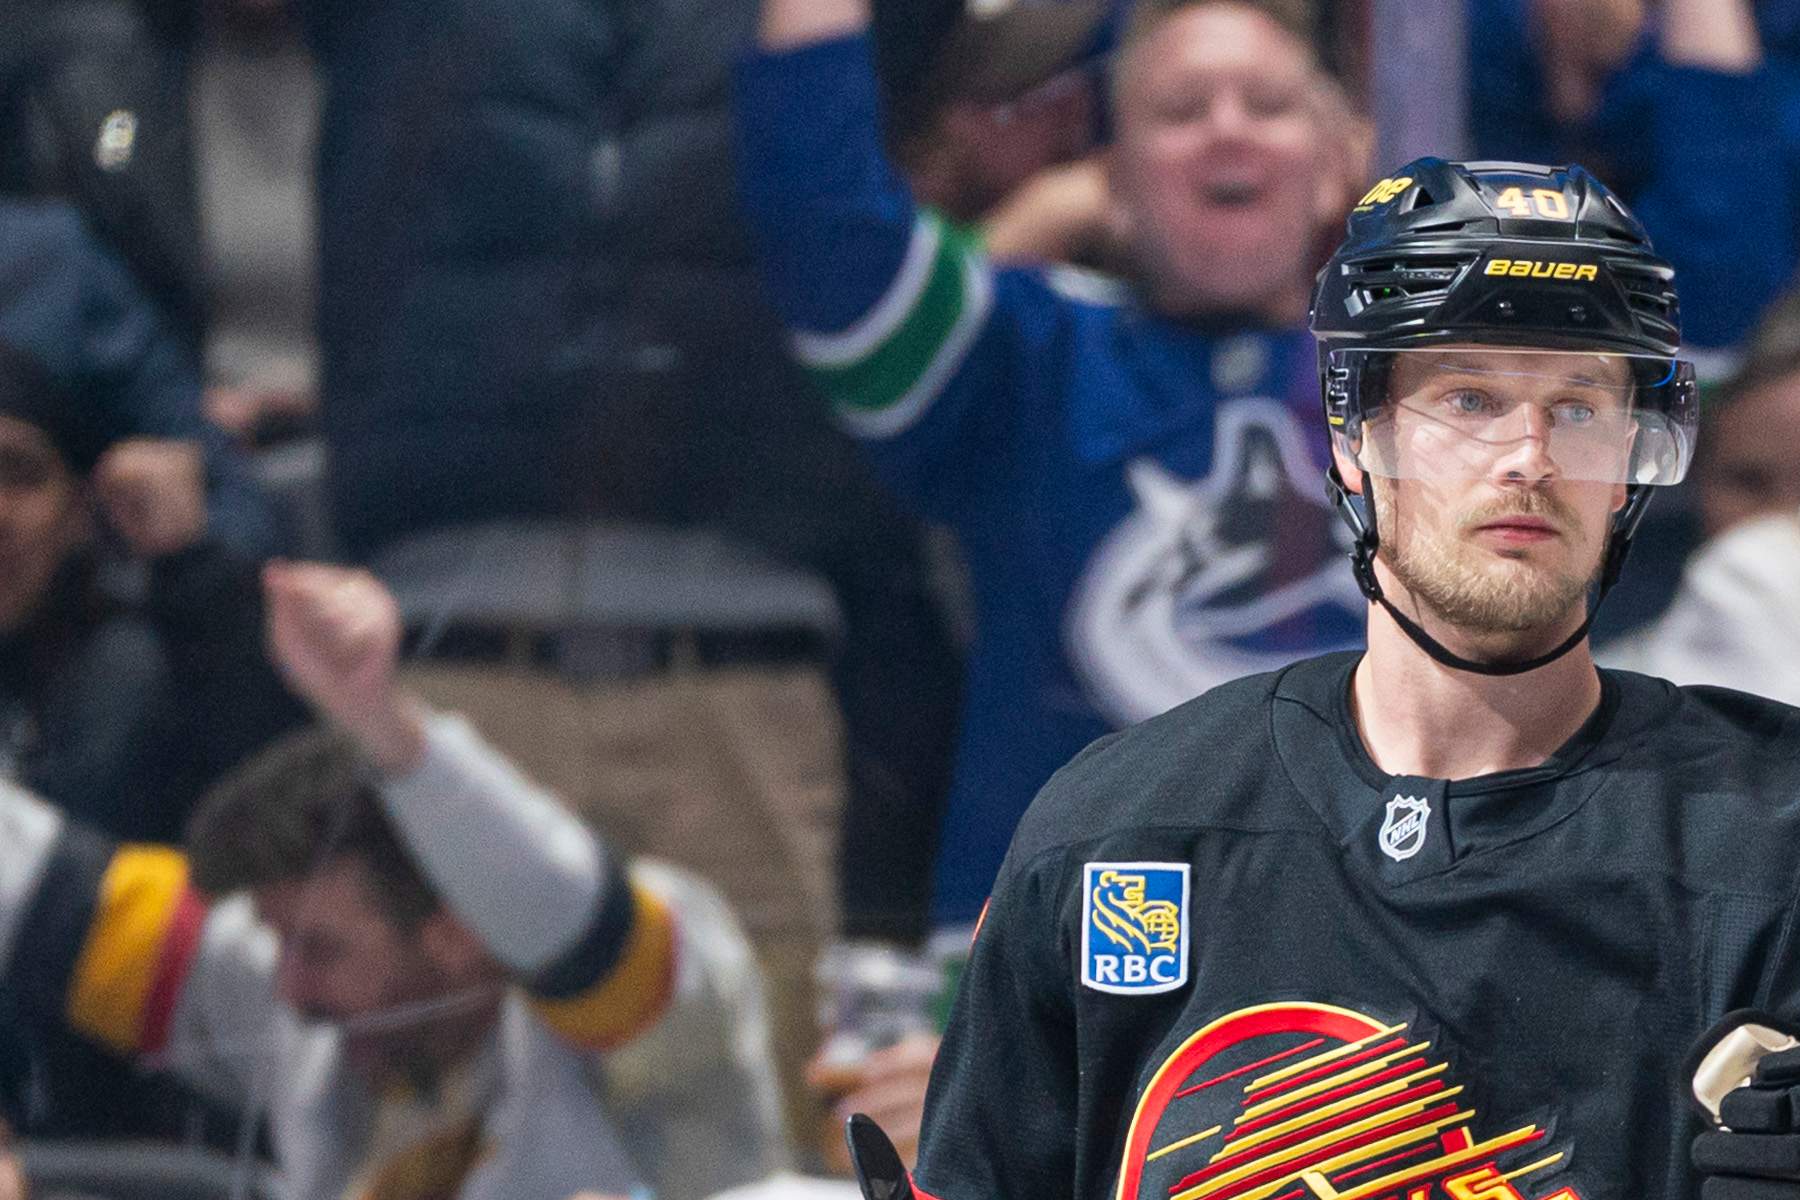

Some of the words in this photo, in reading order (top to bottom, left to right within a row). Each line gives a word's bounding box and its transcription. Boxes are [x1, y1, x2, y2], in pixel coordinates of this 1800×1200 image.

[1496, 186, 1571, 221] 40
[1484, 258, 1600, 282] BAUER
[1093, 953, 1176, 983] RBC
